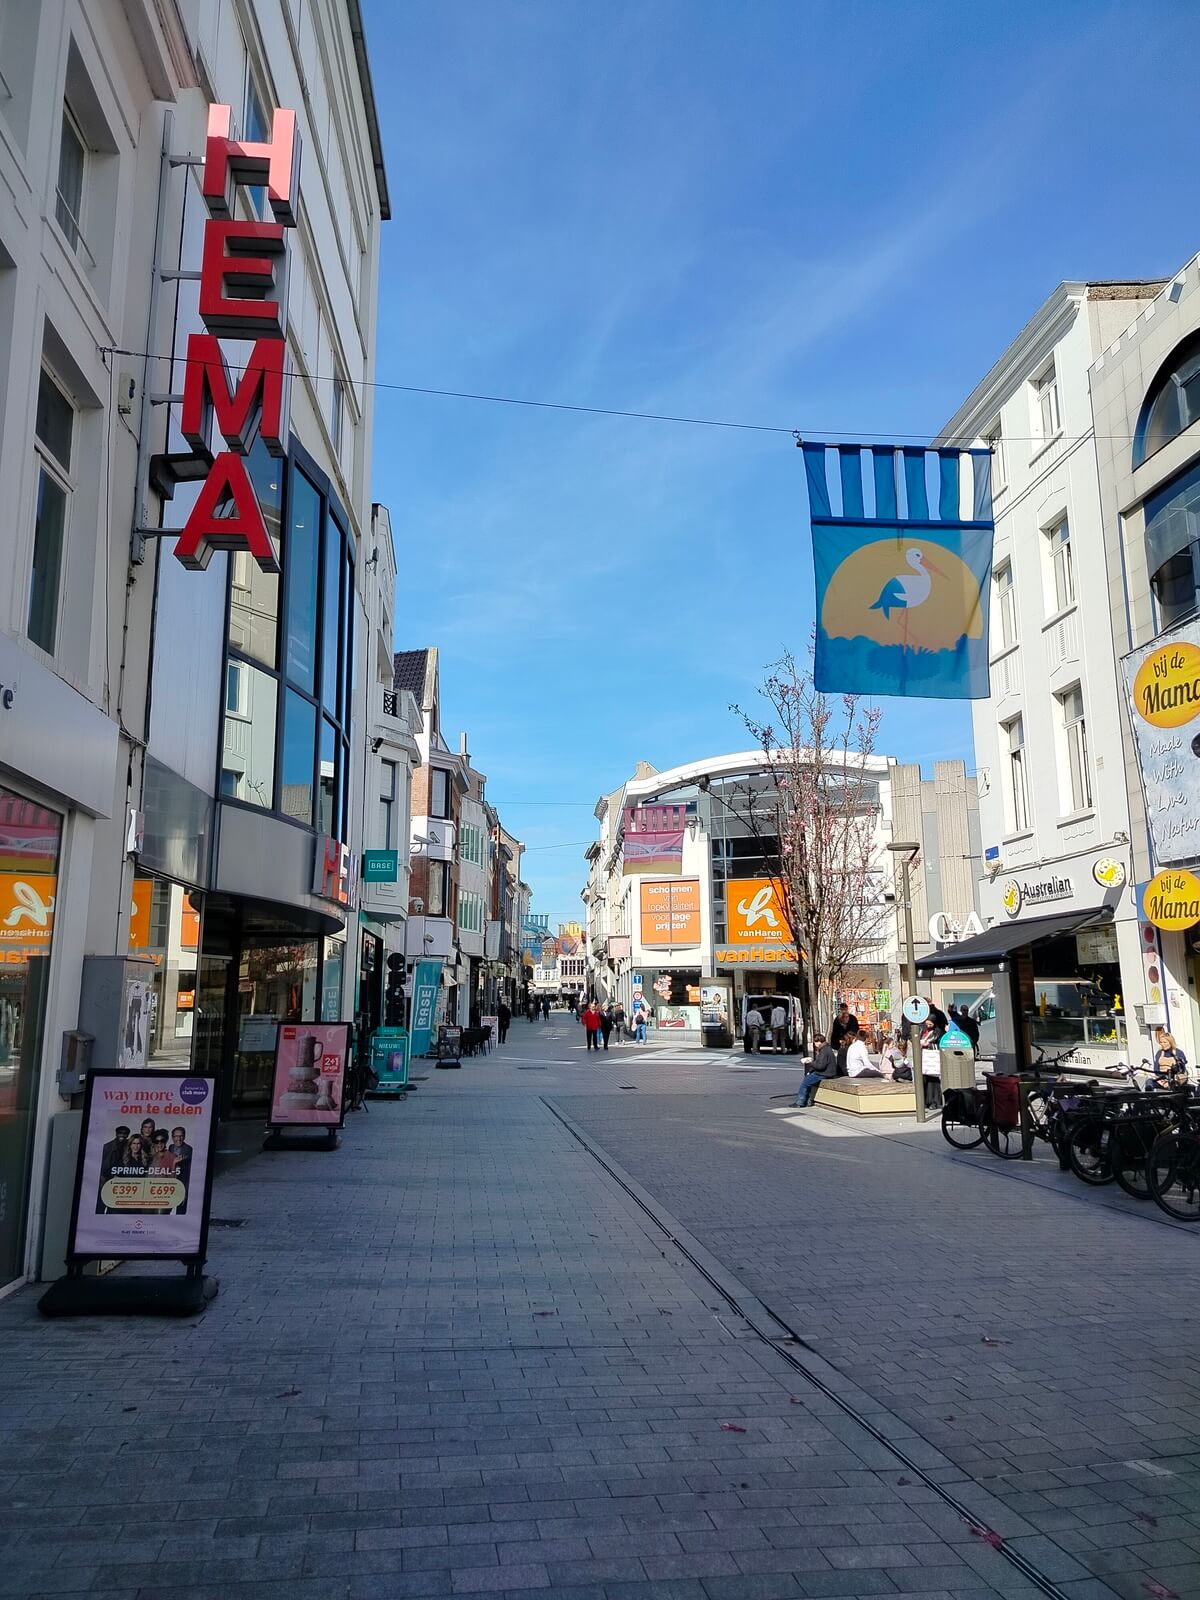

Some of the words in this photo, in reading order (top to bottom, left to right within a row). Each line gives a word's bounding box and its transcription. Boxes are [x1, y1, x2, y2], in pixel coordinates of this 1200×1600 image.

[173, 103, 297, 570] HEMA
[1153, 654, 1167, 678] bij
[1170, 651, 1185, 669] de
[1149, 736, 1182, 758] Made
[1153, 760, 1184, 784] With
[648, 886, 692, 894] schoenen
[1023, 876, 1071, 898] Australian
[1160, 875, 1171, 893] bij
[1174, 876, 1185, 889] de
[1150, 896, 1199, 920] Mama
[671, 913, 691, 922] lage
[655, 922, 687, 932] prijzen
[738, 930, 782, 938] vanHaren
[929, 911, 985, 942] C&A
[716, 947, 808, 963] vanHaren
[417, 990, 431, 1026] BASE
[324, 1057, 339, 1066] 2+1
[103, 1090, 129, 1104] way
[135, 1090, 174, 1101] more
[121, 1105, 142, 1114] om
[147, 1103, 160, 1114] te
[164, 1103, 202, 1115] delen
[111, 1166, 181, 1175] SPRING-DEAL-5
[112, 1186, 138, 1195] €399
[150, 1186, 176, 1195] €699
